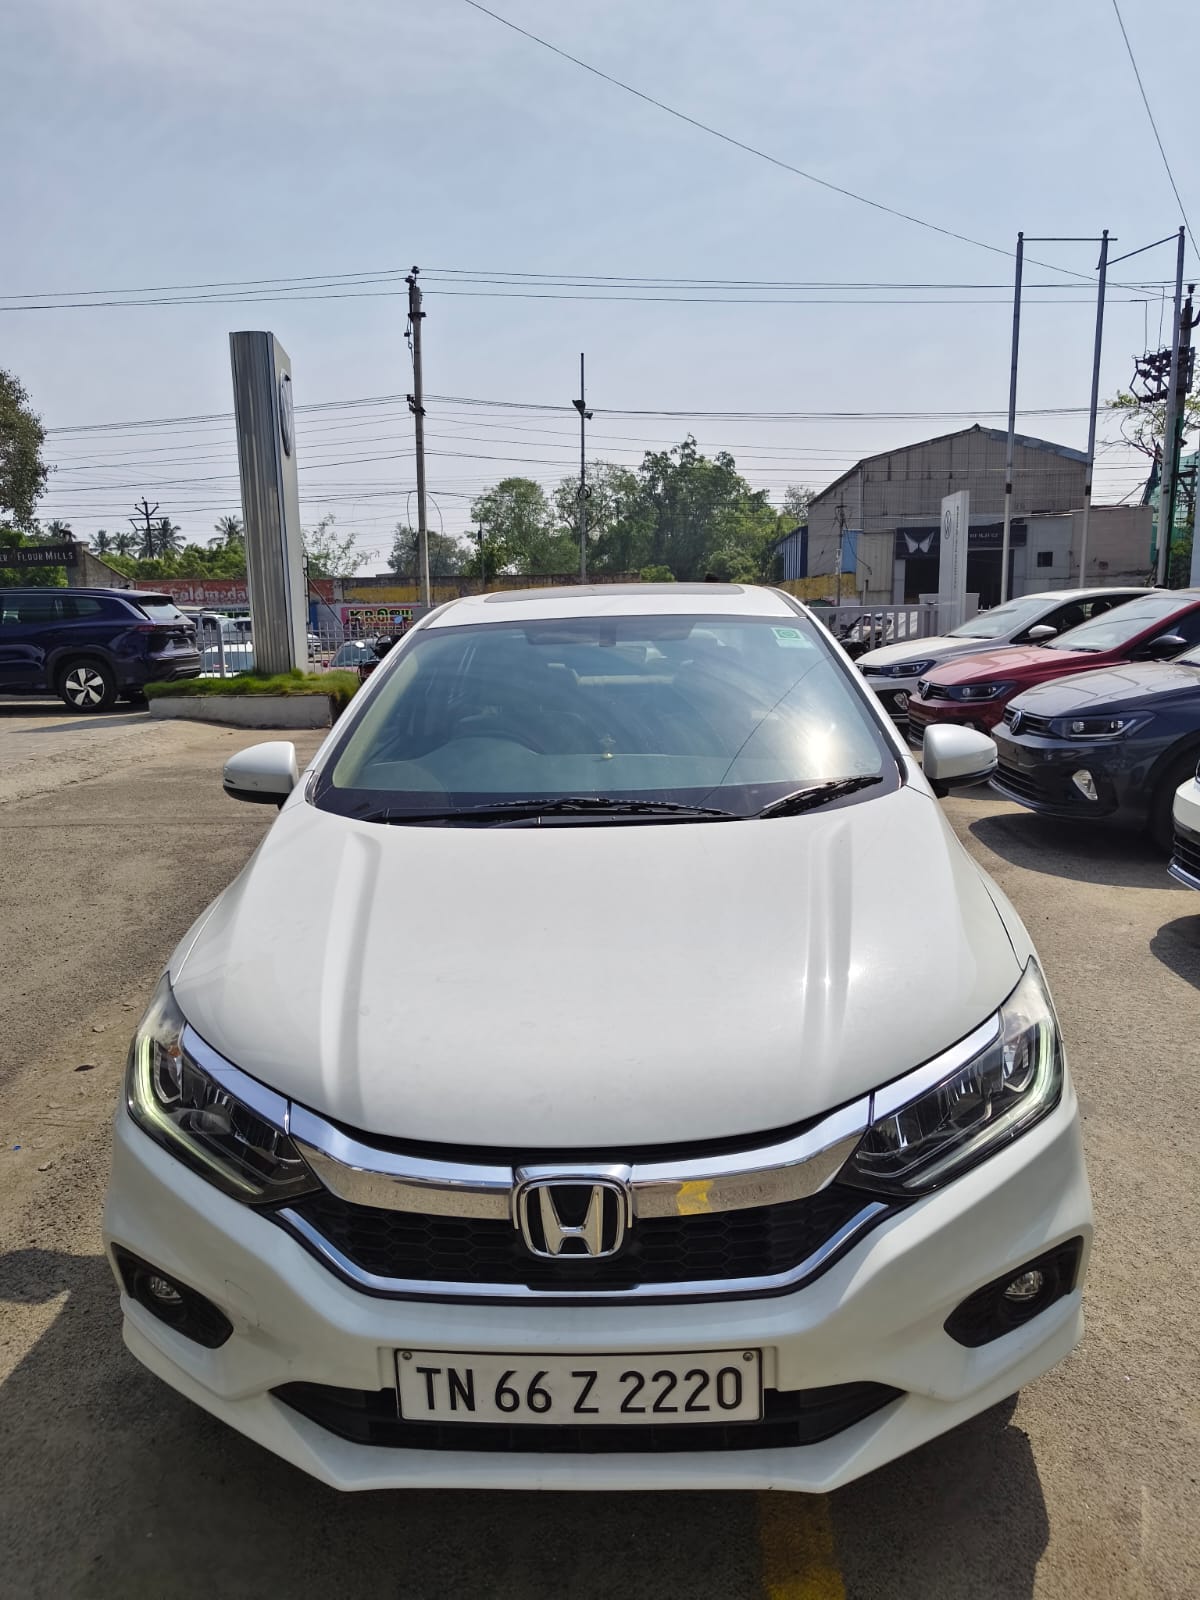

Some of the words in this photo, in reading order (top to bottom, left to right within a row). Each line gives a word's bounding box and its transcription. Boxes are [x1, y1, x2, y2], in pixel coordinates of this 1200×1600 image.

[17, 551, 43, 561] FLOUR
[45, 551, 73, 561] MILLS
[416, 1367, 475, 1411] TN
[495, 1370, 552, 1413] 66
[571, 1371, 599, 1413] Z
[619, 1367, 743, 1413] 2220
